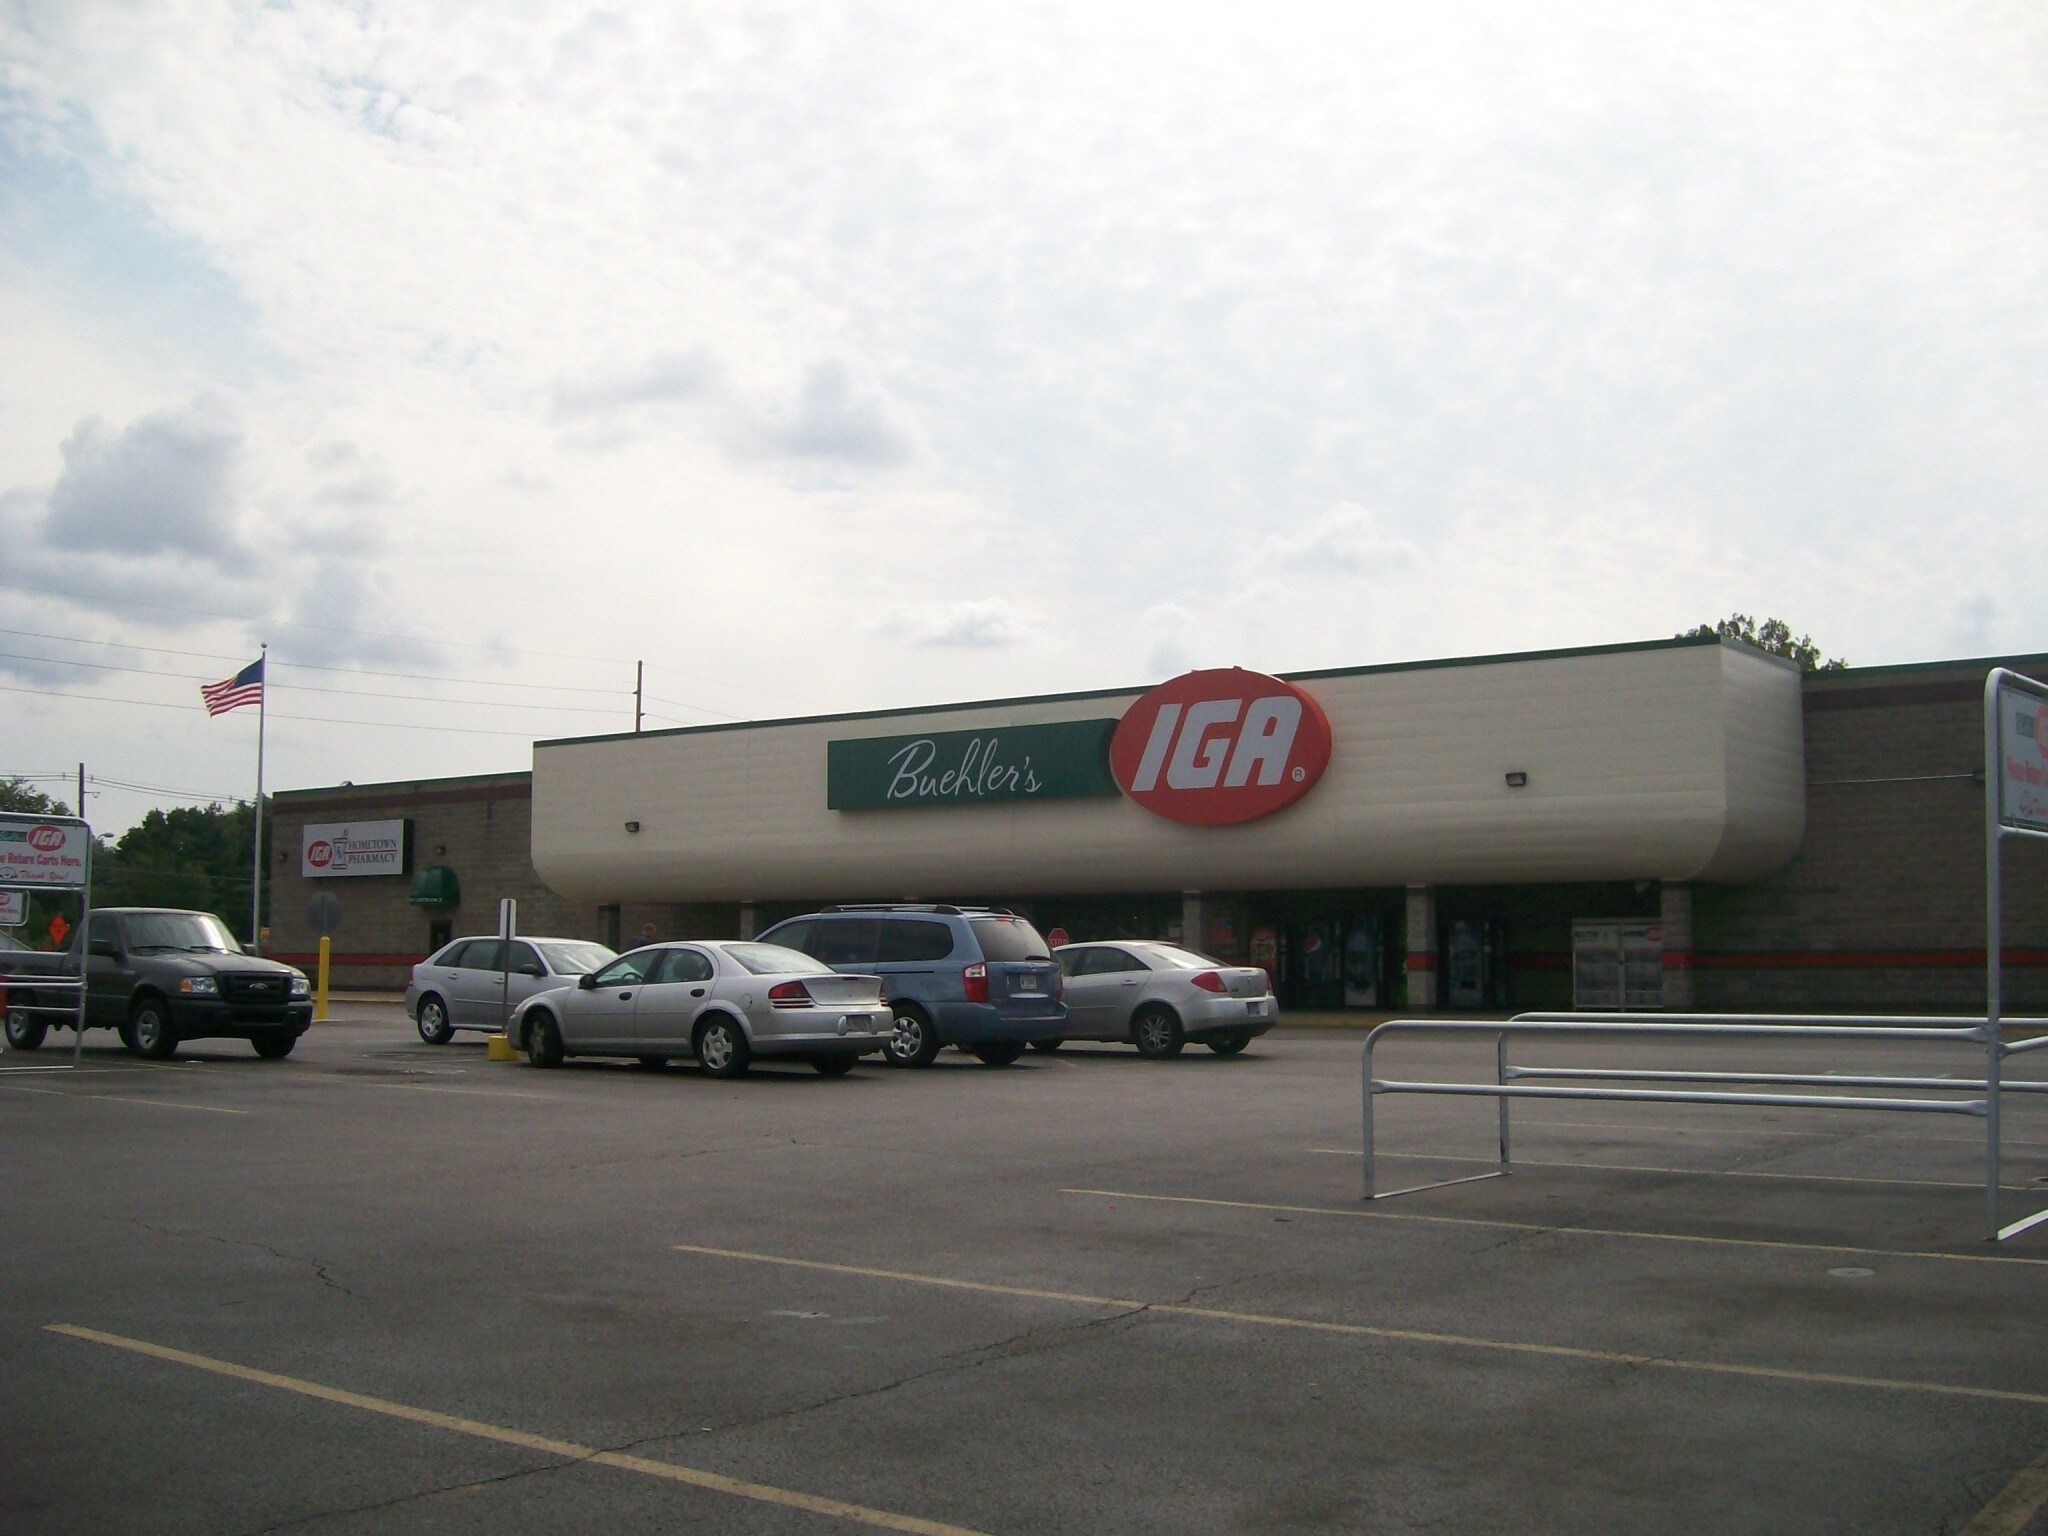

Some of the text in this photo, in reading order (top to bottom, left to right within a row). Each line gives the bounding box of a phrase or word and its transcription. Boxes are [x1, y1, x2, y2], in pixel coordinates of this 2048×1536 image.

[1131, 695, 1303, 792] IGA
[887, 737, 1042, 800] Buehler's
[32, 830, 63, 846] IGA
[348, 839, 397, 850] HOMETOWN
[7, 852, 35, 865] Return
[37, 854, 59, 866] Carts
[310, 845, 332, 861] IGA
[348, 853, 396, 864] PHARMACY
[20, 870, 45, 880] Thank
